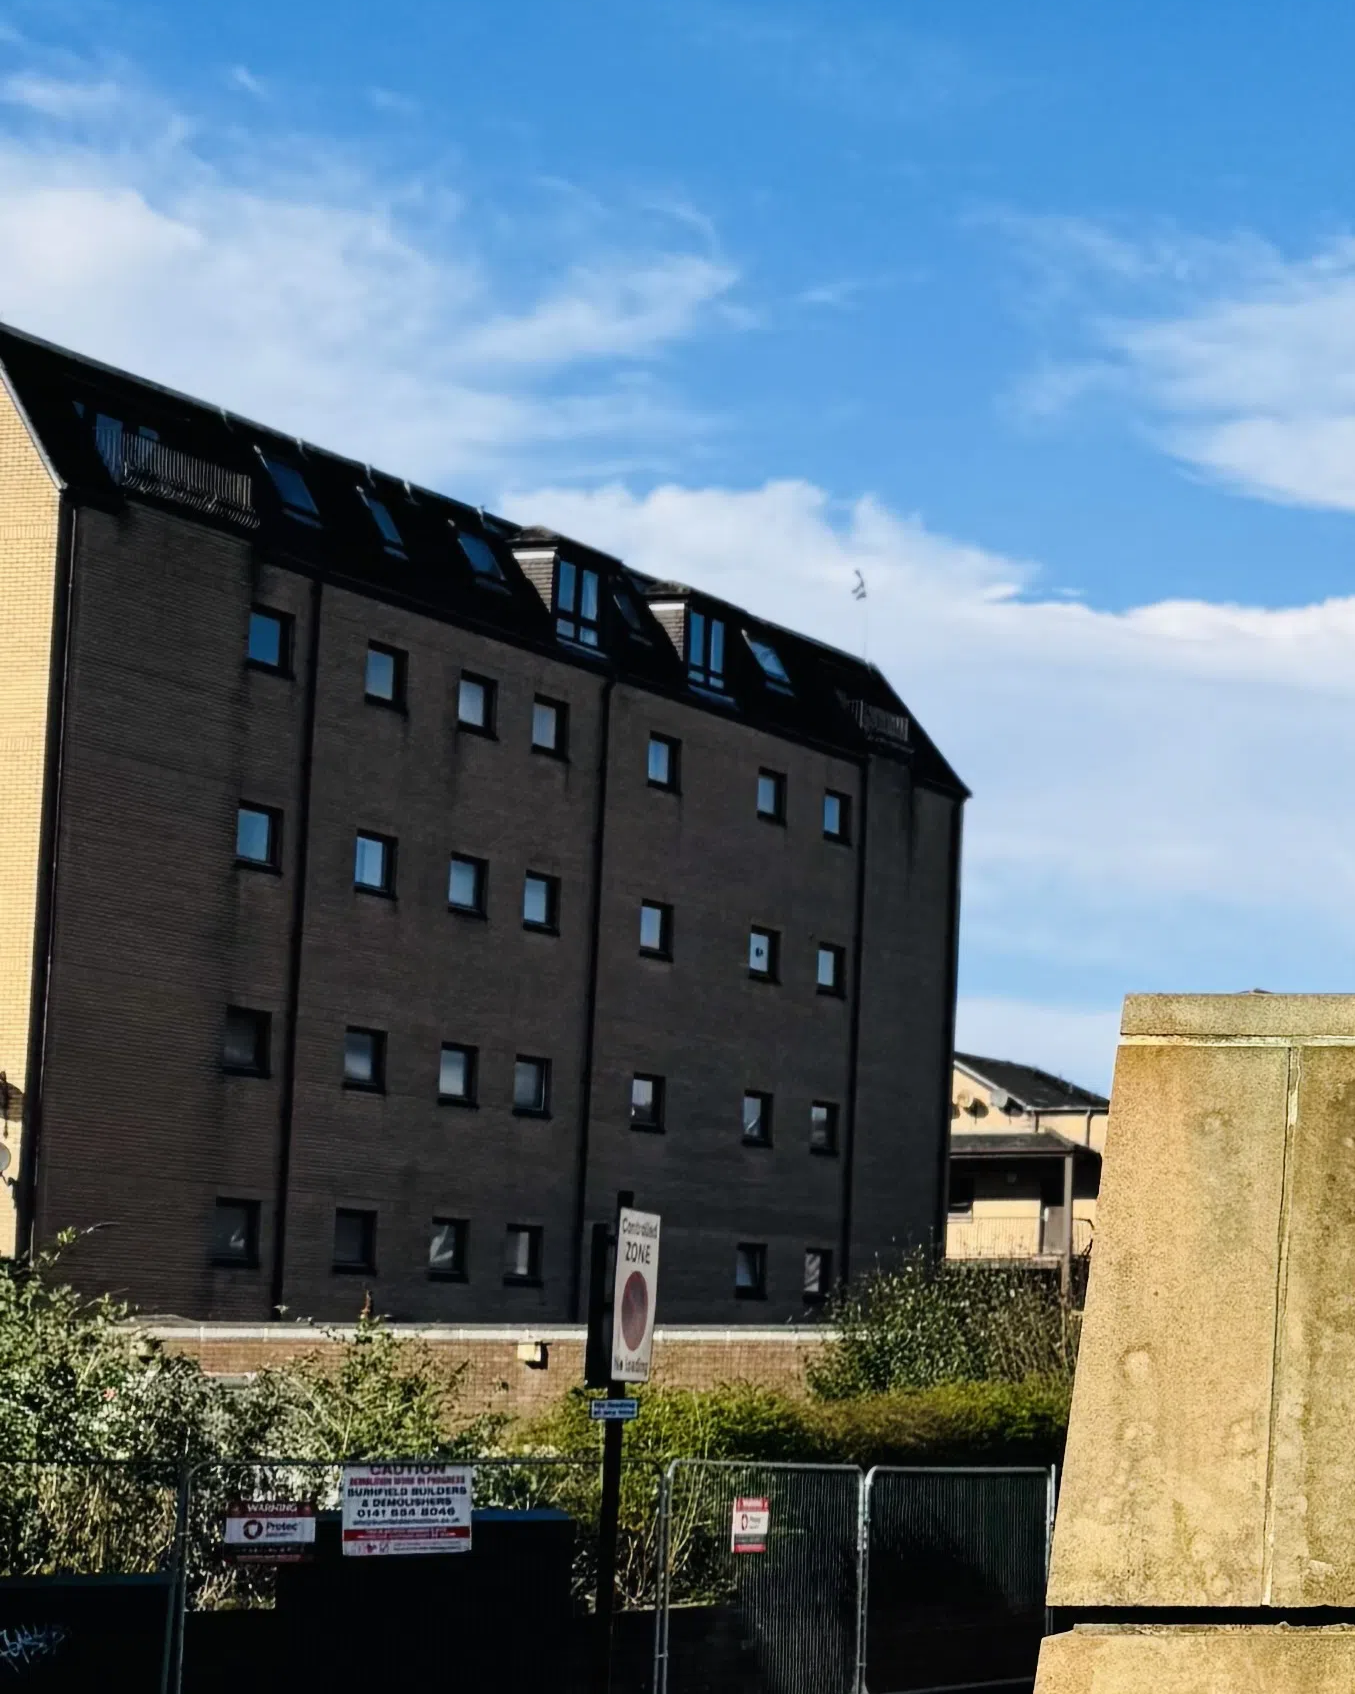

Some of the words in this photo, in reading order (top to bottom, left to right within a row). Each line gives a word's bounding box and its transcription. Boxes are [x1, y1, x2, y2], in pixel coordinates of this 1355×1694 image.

[625, 1241, 651, 1265] ZONE
[370, 1465, 446, 1475] CAUTION
[412, 1486, 467, 1496] BUILDERS
[373, 1497, 452, 1507] DEMOLISHERS
[247, 1503, 298, 1512] WARNING
[357, 1509, 386, 1518] 0141
